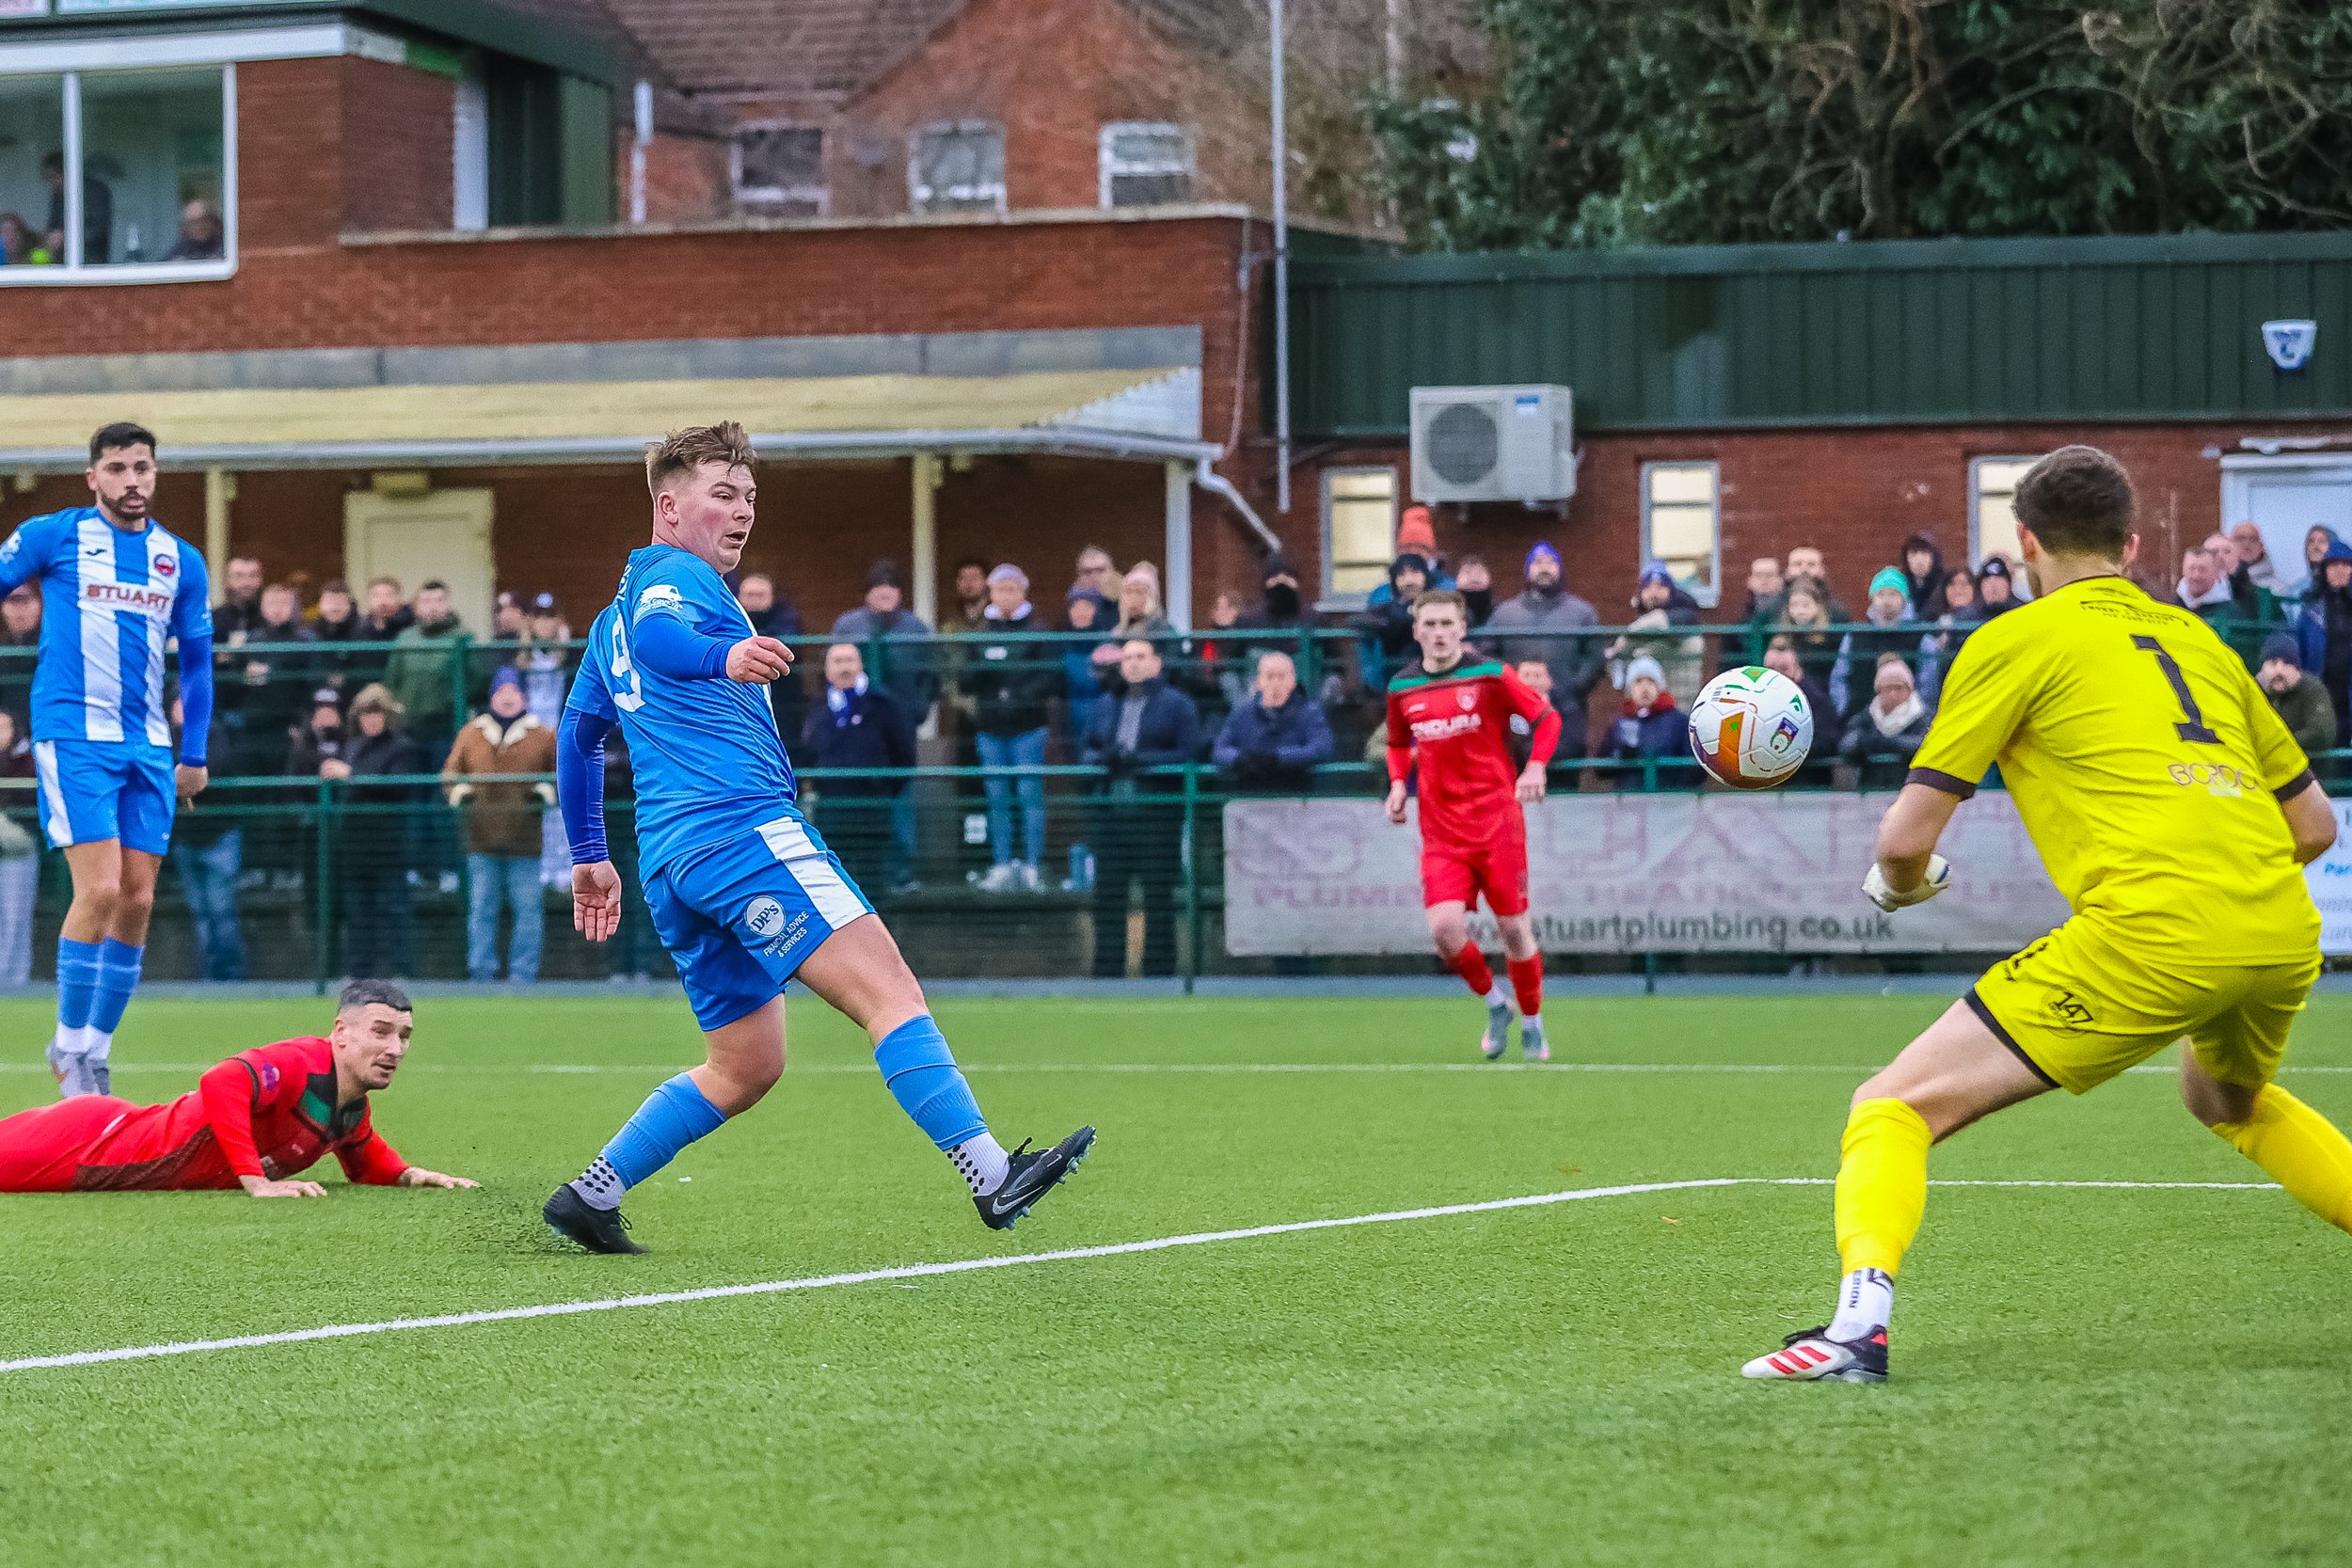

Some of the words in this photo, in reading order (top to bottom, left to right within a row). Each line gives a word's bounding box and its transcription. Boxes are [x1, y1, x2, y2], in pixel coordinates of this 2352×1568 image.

[87, 584, 169, 613] STUART
[612, 613, 646, 712] 9
[2129, 633, 2226, 745] 1
[763, 931, 789, 958] FINANCIAL
[786, 911, 810, 938] ADVICE
[782, 927, 808, 955] SERVICES
